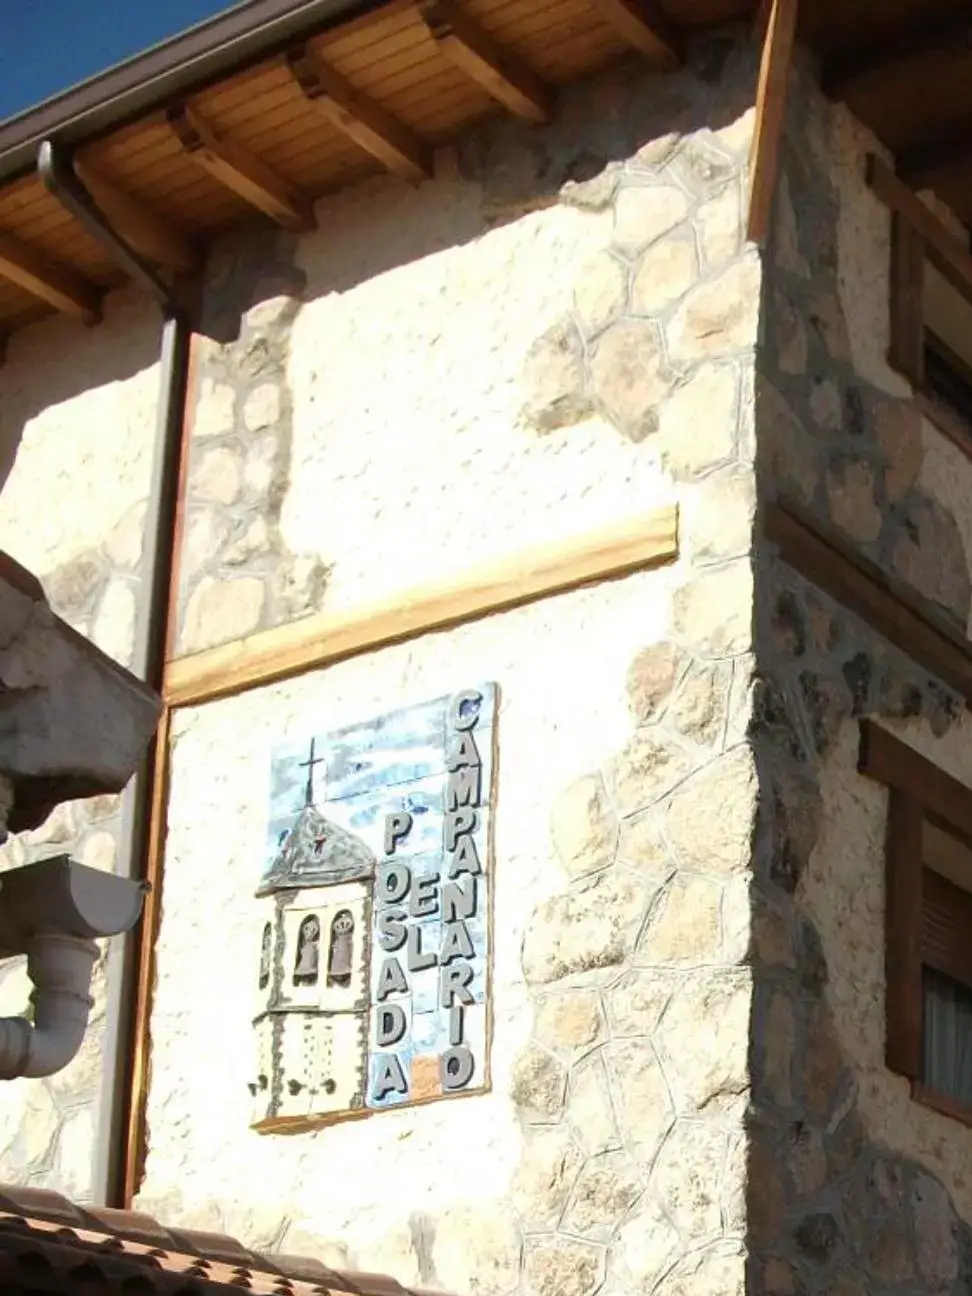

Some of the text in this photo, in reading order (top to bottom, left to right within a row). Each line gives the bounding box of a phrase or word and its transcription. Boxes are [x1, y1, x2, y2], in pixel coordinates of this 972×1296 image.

[374, 811, 413, 1102] POSADA
[409, 873, 440, 973] EL
[442, 690, 482, 1090] CAMPANARIO
